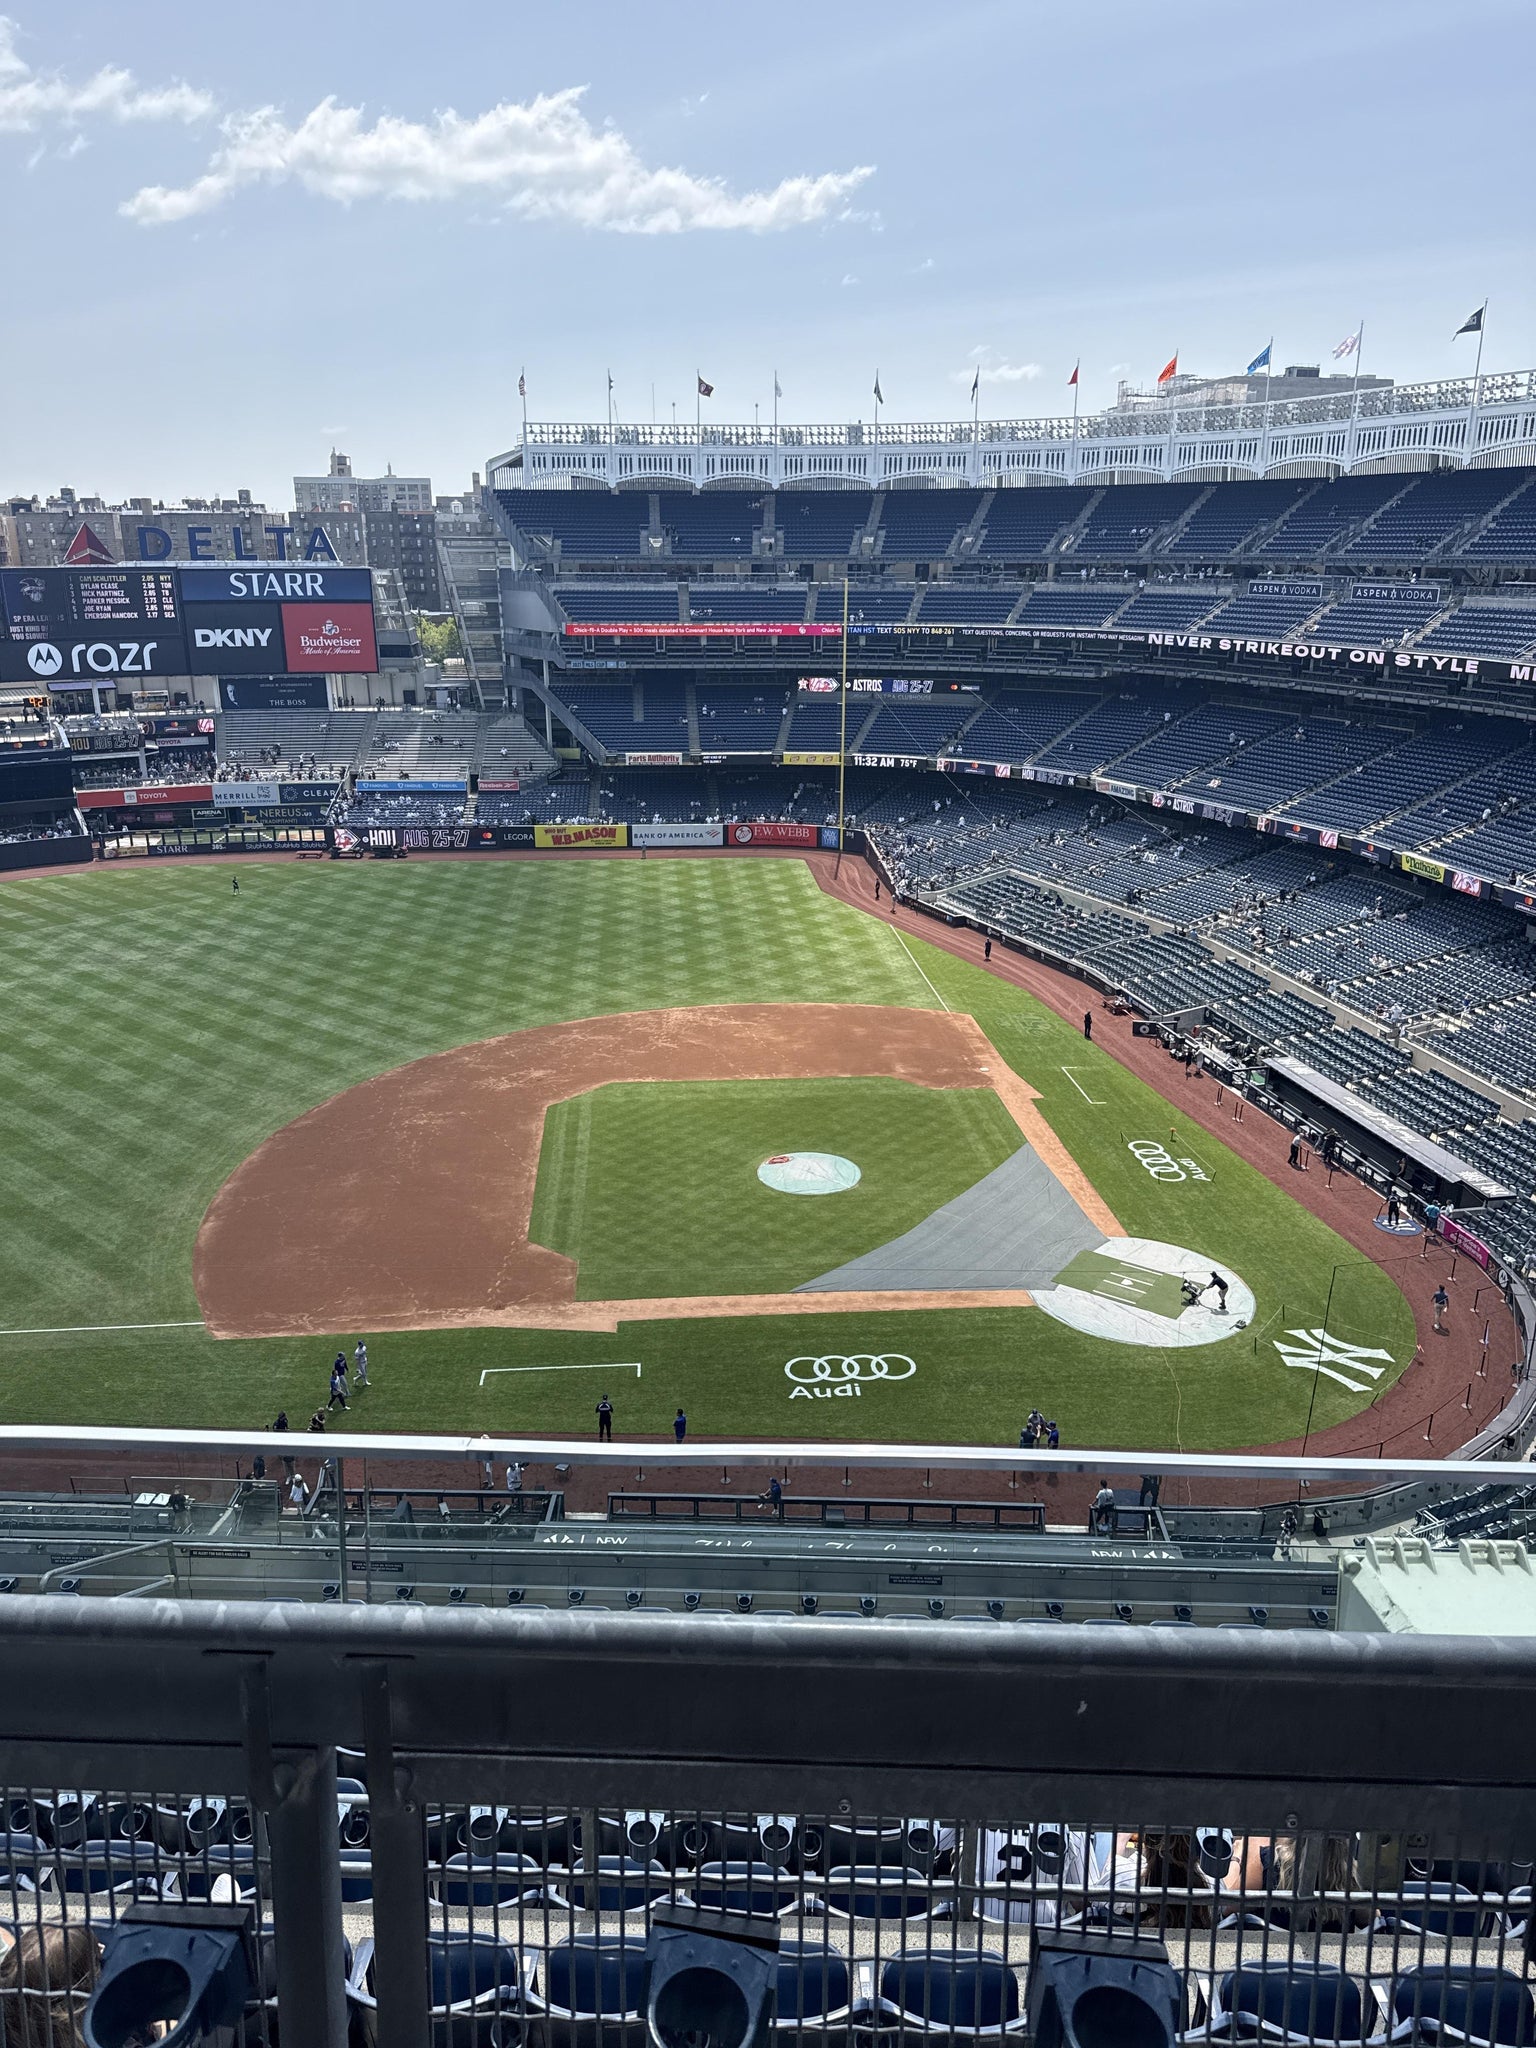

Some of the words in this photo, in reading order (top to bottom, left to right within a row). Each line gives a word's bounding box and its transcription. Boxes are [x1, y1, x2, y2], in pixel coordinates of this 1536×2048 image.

[137, 526, 341, 561] DELTA
[229, 572, 325, 597] STARR
[1252, 585, 1280, 594] ASPEN
[1289, 586, 1317, 595] VODKA
[1356, 588, 1388, 598] ASPEN
[1400, 590, 1433, 600] VODKA
[194, 628, 273, 648] DKNY
[300, 636, 361, 646] Budweiser
[1119, 634, 1145, 642] MESSAGING
[71, 642, 158, 673] razr
[1148, 634, 1211, 649] NEVER
[1219, 639, 1342, 660] STRIKEOUT
[1350, 650, 1385, 664] ON
[1394, 654, 1480, 674] STYLE
[852, 679, 882, 692] ASTROS
[892, 680, 908, 692] AUG
[71, 737, 90, 750] HOU
[628, 755, 646, 763] Parts
[648, 754, 680, 764] Authority
[854, 756, 878, 766] 11:32
[880, 758, 894, 768] AM
[900, 759, 918, 768] 75°F
[1022, 769, 1034, 780] HOU
[215, 792, 256, 800] MERRILL
[1172, 799, 1195, 814] ASTROS
[754, 826, 774, 836] F.W.
[776, 827, 810, 838] WEBB
[369, 830, 396, 846] HOU
[403, 830, 430, 848] AUG
[432, 830, 470, 848] 25-27
[156, 845, 188, 854] STARR
[1406, 856, 1440, 876] Nathan's
[1177, 1158, 1212, 1182] Audi
[788, 1383, 862, 1400] Audi
